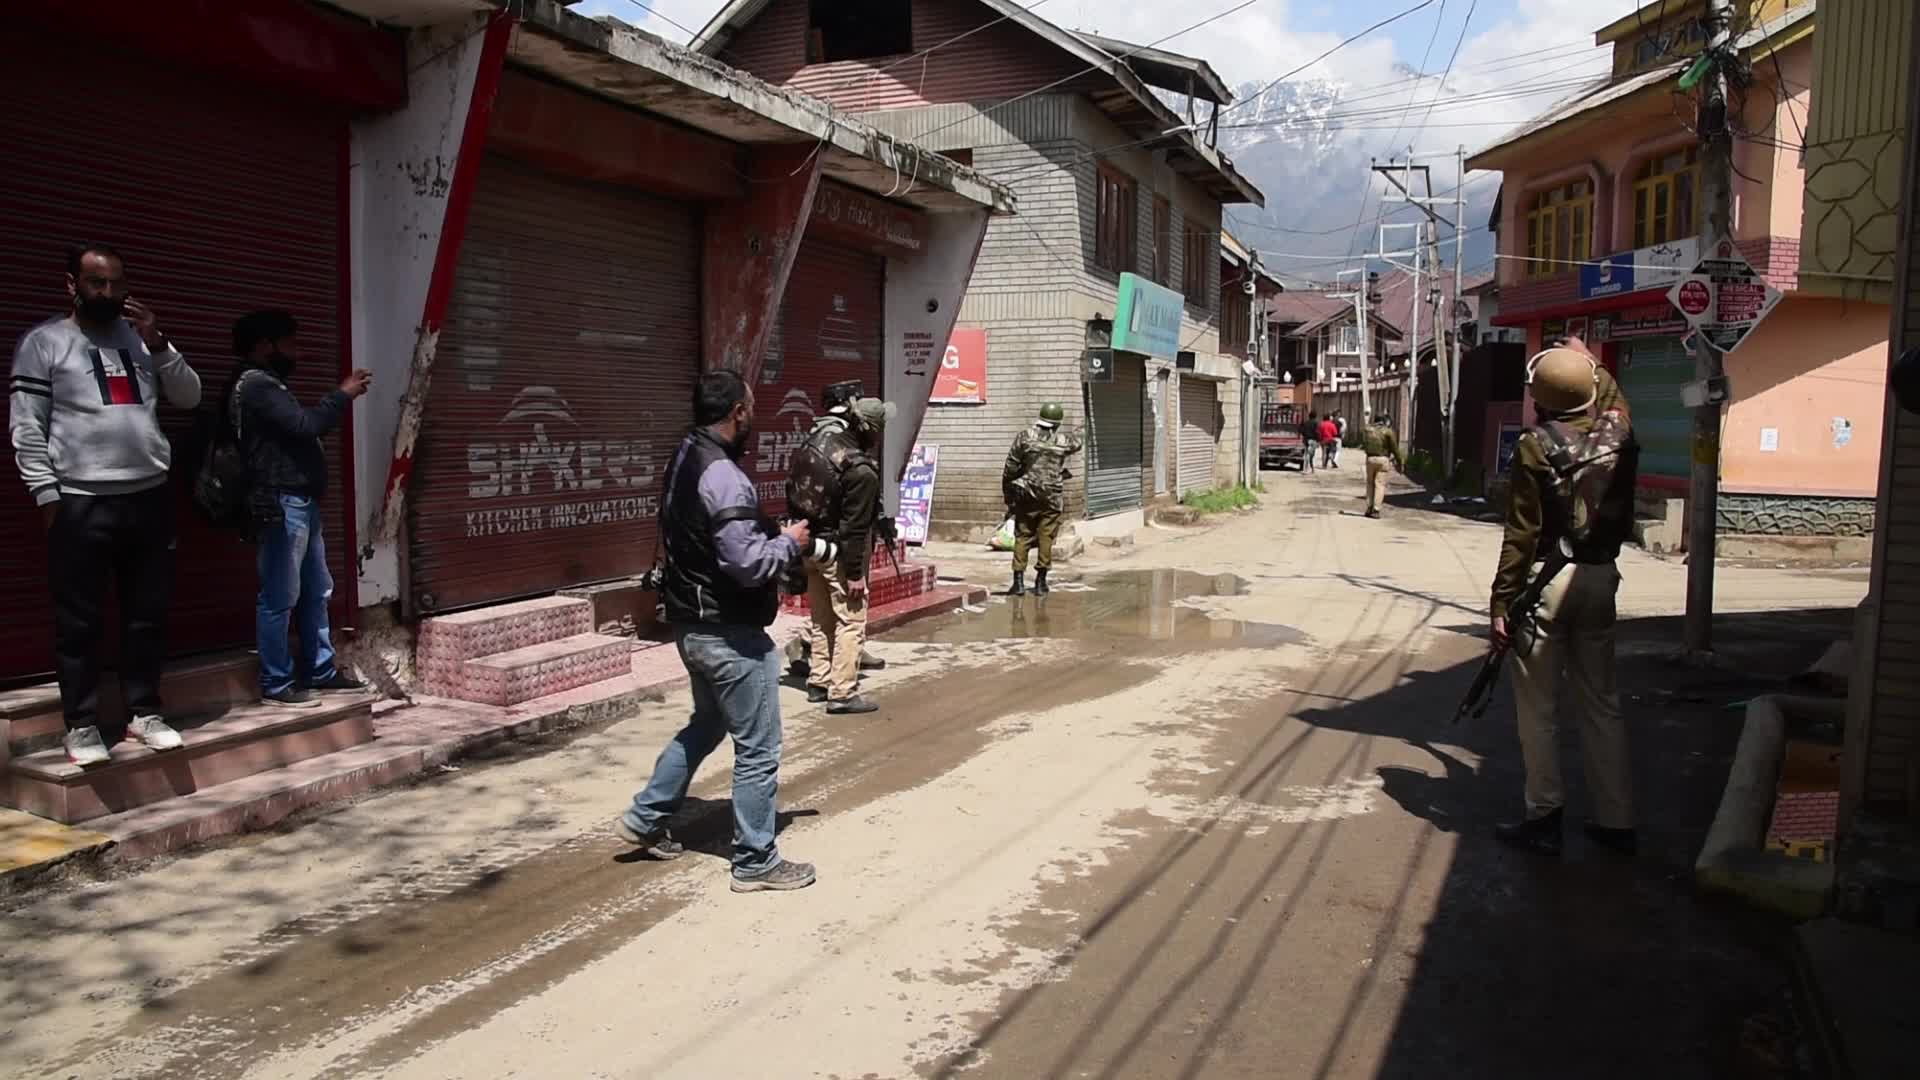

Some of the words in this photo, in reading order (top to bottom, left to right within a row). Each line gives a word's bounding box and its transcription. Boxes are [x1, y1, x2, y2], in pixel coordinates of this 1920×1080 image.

[467, 426, 656, 498] SHAKERS
[465, 503, 545, 537] KITCHEN
[549, 495, 660, 530] INNOVATIONS
